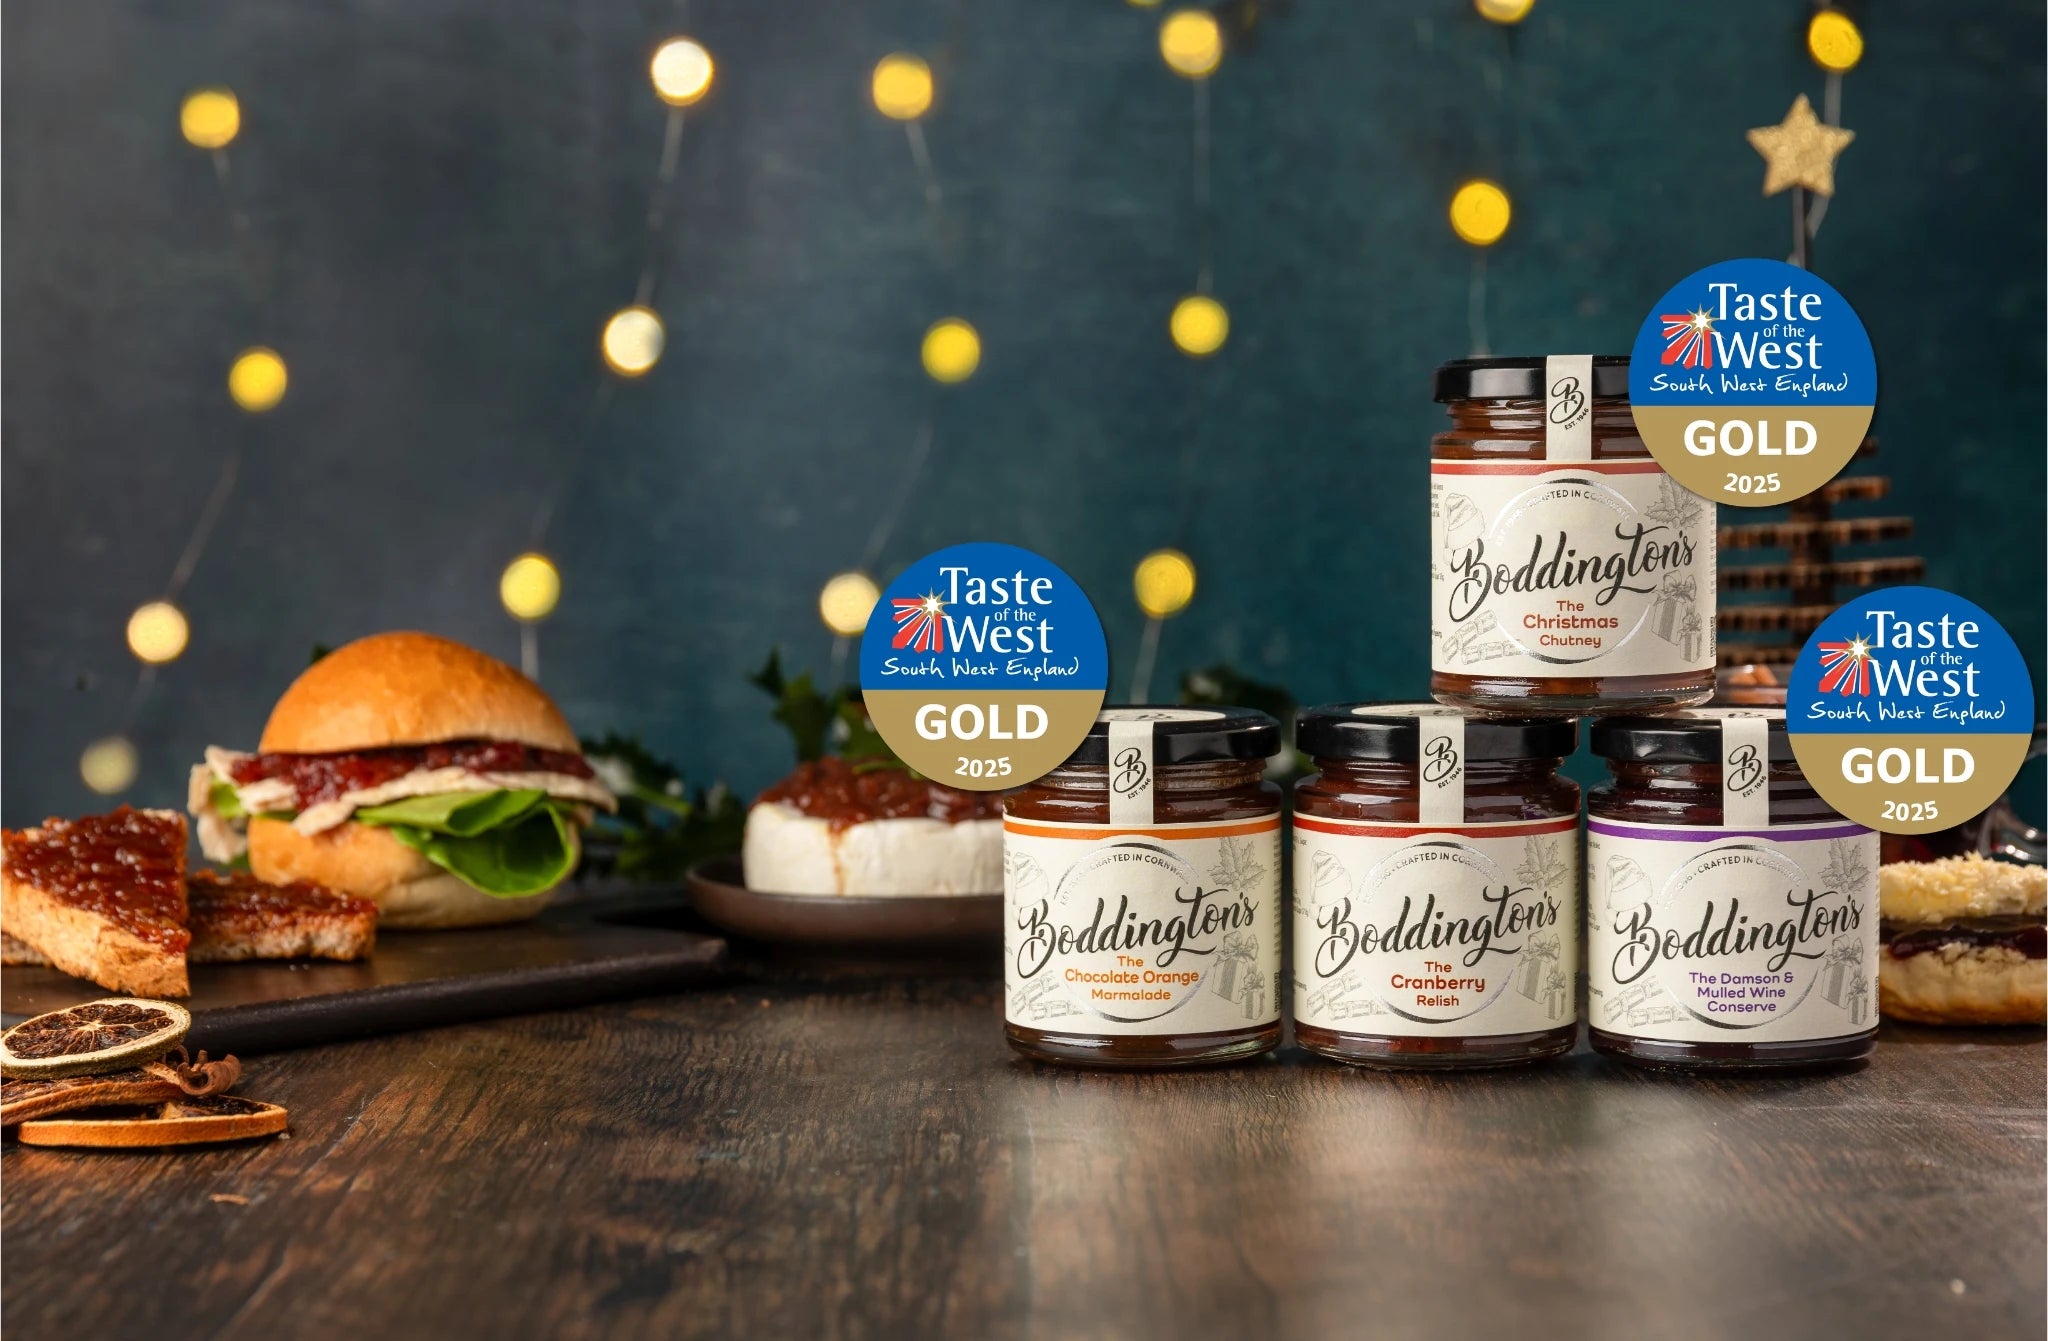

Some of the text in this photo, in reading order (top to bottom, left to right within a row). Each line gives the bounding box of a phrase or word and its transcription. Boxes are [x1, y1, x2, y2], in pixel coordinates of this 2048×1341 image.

[1449, 523, 1697, 622] Boddington's
[1556, 600, 1584, 611] The
[1523, 615, 1618, 629] Christmas
[1540, 635, 1601, 648] Chutney
[1440, 852, 1449, 860] IN
[1145, 855, 1189, 884] CORNWA
[1698, 856, 1740, 873] CRAFTED
[1743, 856, 1753, 864] IN
[1017, 887, 1259, 979] Boddington's
[1315, 885, 1561, 978] Boddington's
[1612, 889, 1864, 984] Boddington's
[1117, 956, 1144, 967] The
[1424, 962, 1452, 972] The
[1065, 969, 1199, 983] Chocolate Orange
[1689, 972, 1793, 984] The Damson &
[1391, 975, 1485, 992] Cranberry
[1092, 990, 1171, 1000] Marmalade
[1697, 987, 1785, 998] Mulled Wine
[1417, 995, 1459, 1006] Relish
[1707, 1001, 1776, 1012] Conserve
